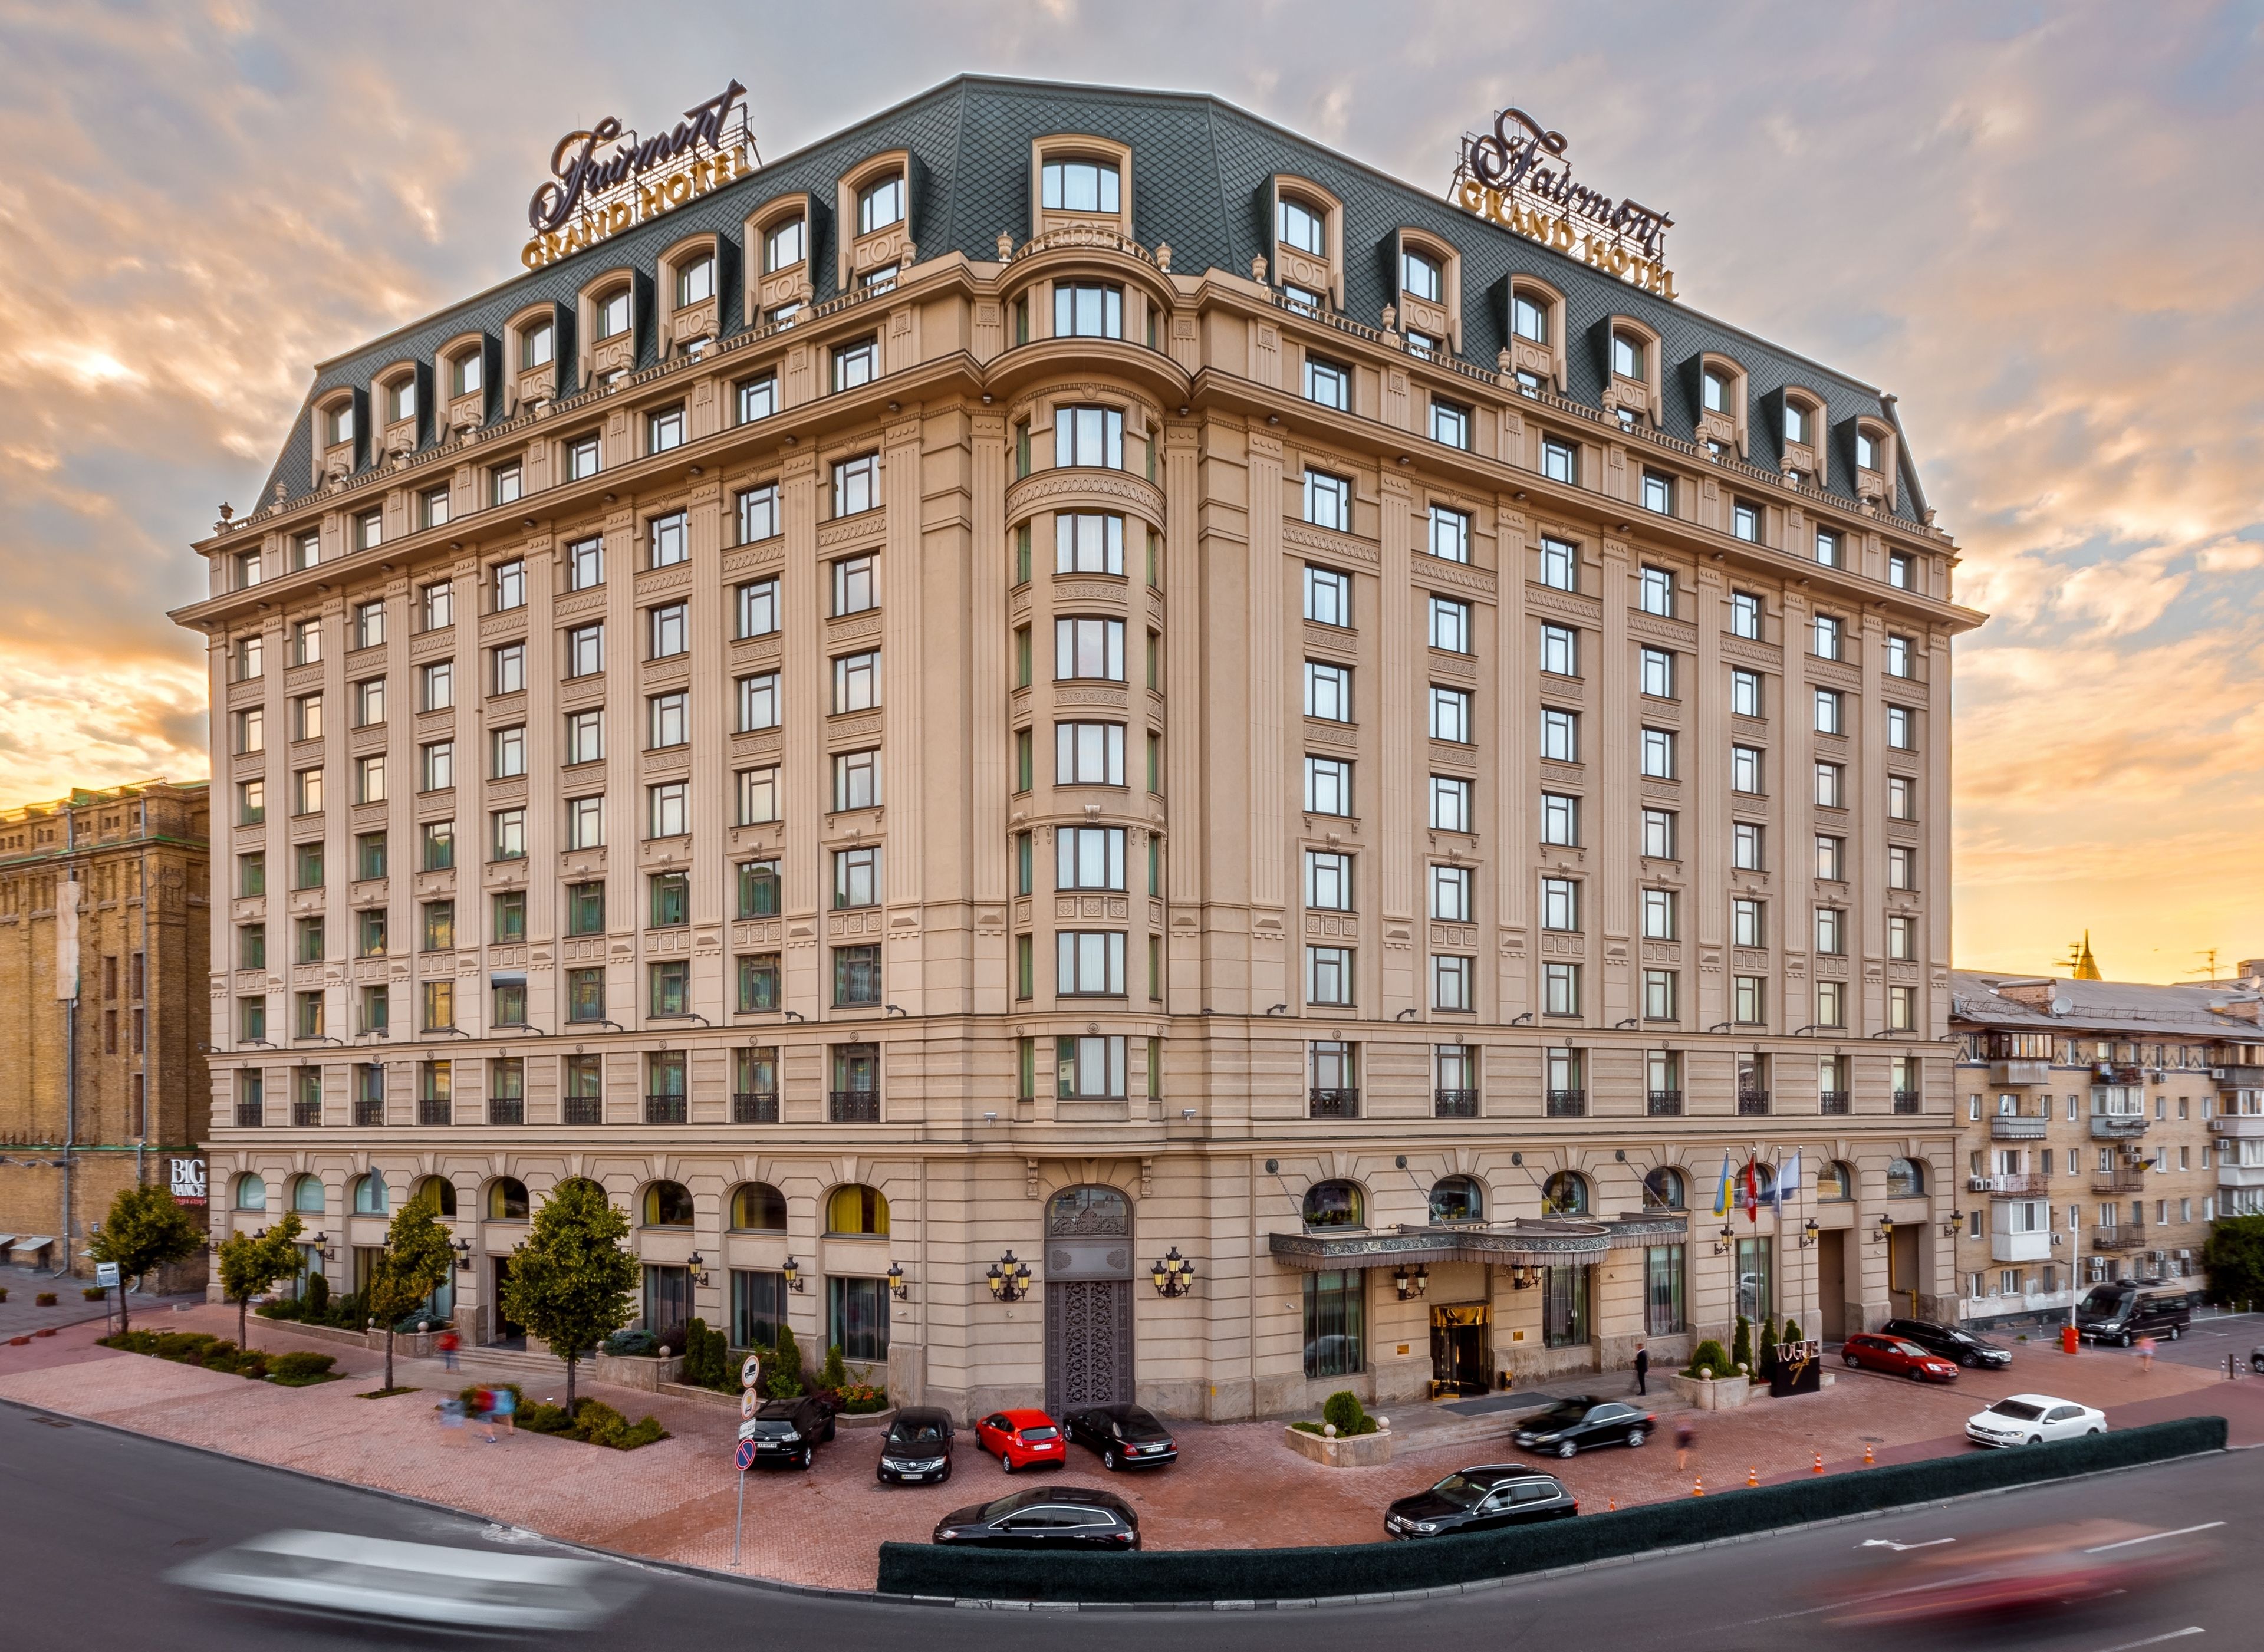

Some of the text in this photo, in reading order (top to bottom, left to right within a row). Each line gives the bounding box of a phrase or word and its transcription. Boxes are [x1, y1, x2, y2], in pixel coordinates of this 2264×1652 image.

[521, 146, 752, 269] GRAND HOTEL
[528, 78, 747, 233] Fairmont
[1470, 108, 1676, 256] Fairmont
[1458, 180, 1679, 300] GRAND HOTEL
[170, 1159, 207, 1184] BIG
[170, 1183, 207, 1197] DANCE
[1772, 1339, 1819, 1362] VOGUE
